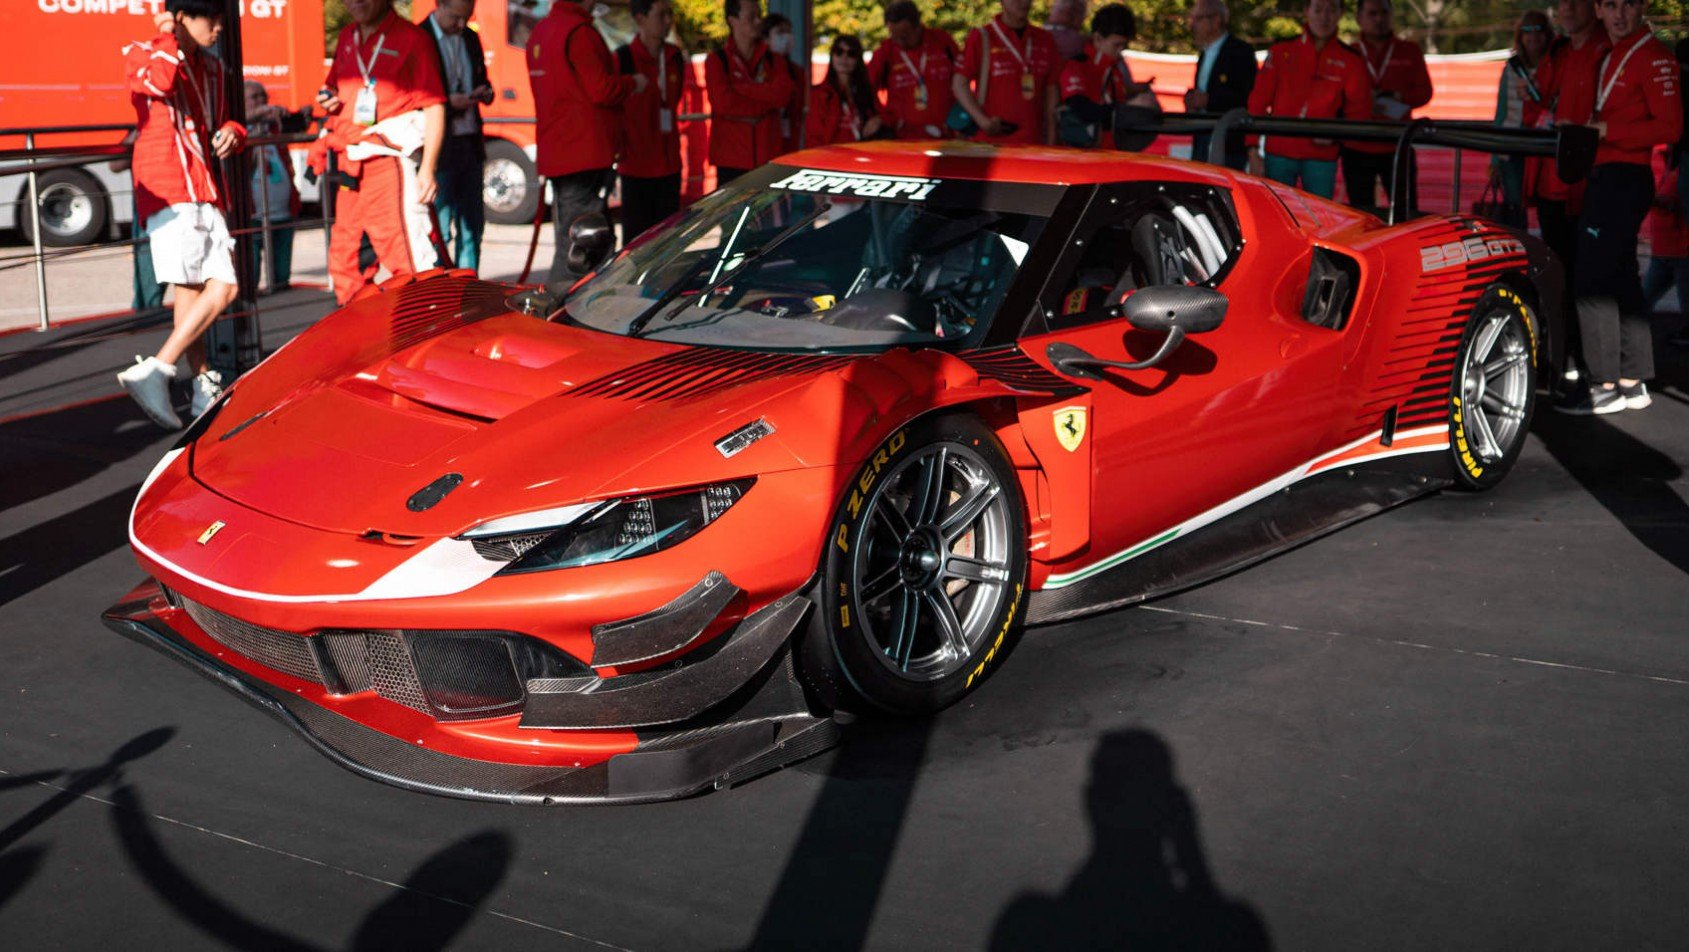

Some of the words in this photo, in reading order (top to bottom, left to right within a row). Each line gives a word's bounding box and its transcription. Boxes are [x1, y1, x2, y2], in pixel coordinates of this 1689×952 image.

[250, 0, 287, 18] GT
[769, 168, 942, 200] Ferrari
[1420, 237, 1489, 273] 296
[1453, 396, 1484, 478] PIRELLI
[837, 523, 849, 553] P
[847, 429, 906, 520] ZERO
